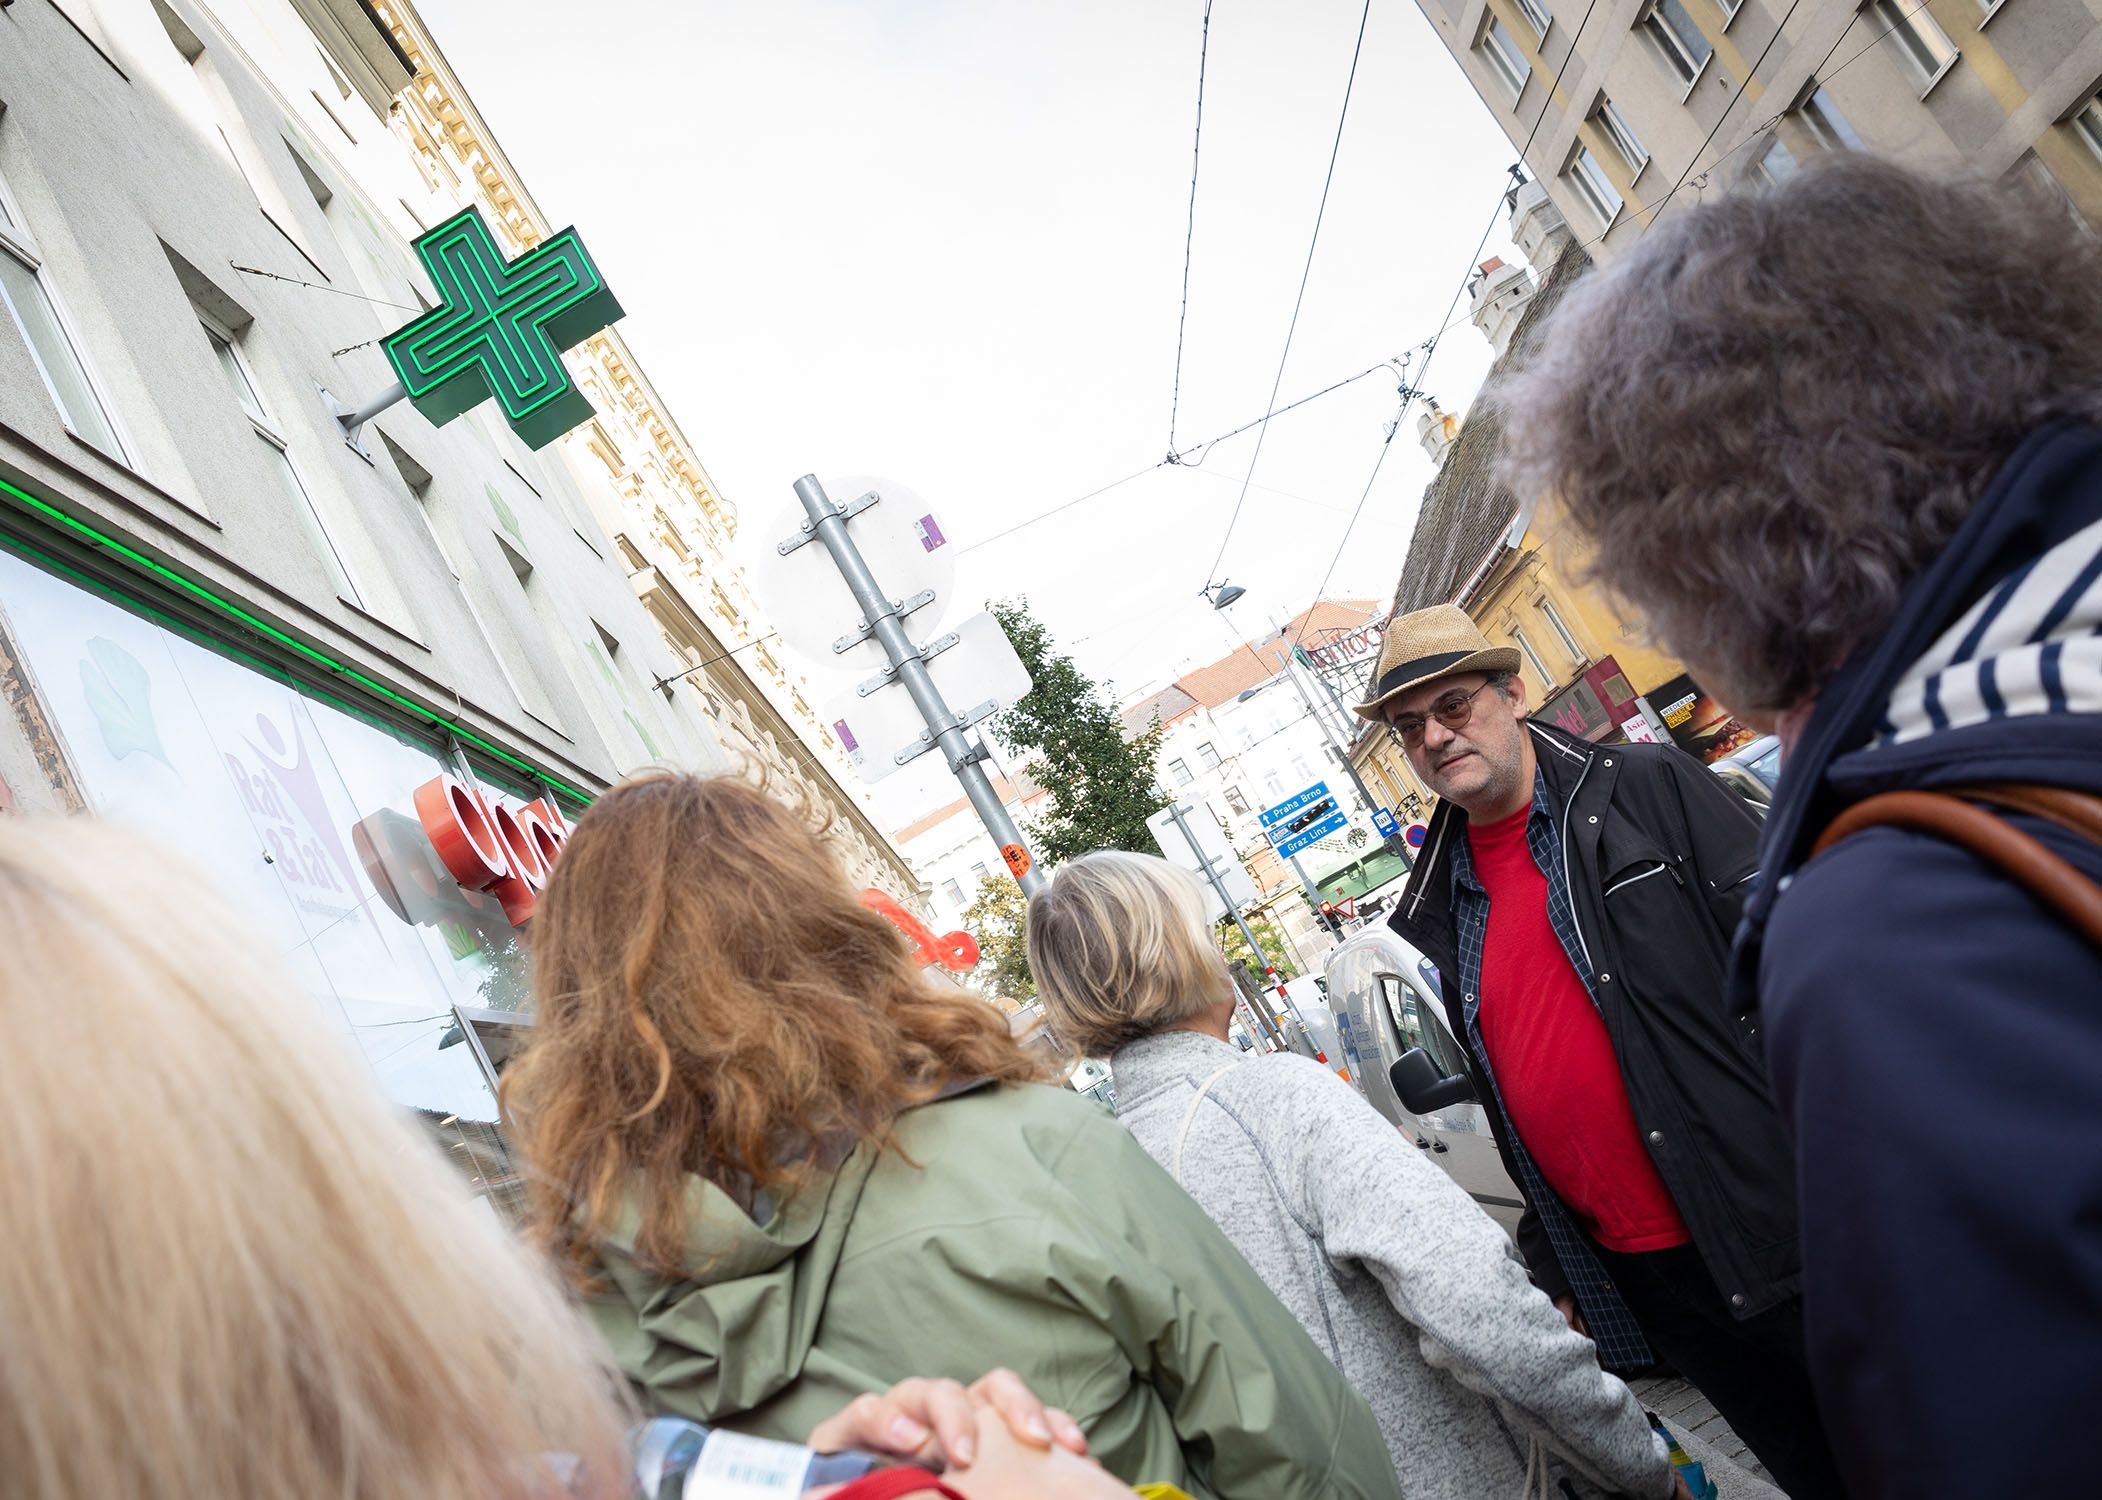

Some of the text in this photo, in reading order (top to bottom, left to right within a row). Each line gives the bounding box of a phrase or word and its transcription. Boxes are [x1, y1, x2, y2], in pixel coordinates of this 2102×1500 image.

[1662, 700, 1684, 715] WIEDER
[1666, 707, 1687, 720] CHEESE
[1626, 718, 1647, 733] Asia
[1670, 714, 1690, 726] BACON
[224, 752, 294, 825] Rat
[1273, 787, 1322, 817] Praha Brno
[1376, 815, 1390, 825] Taxi
[1287, 825, 1328, 852] Graz Linz
